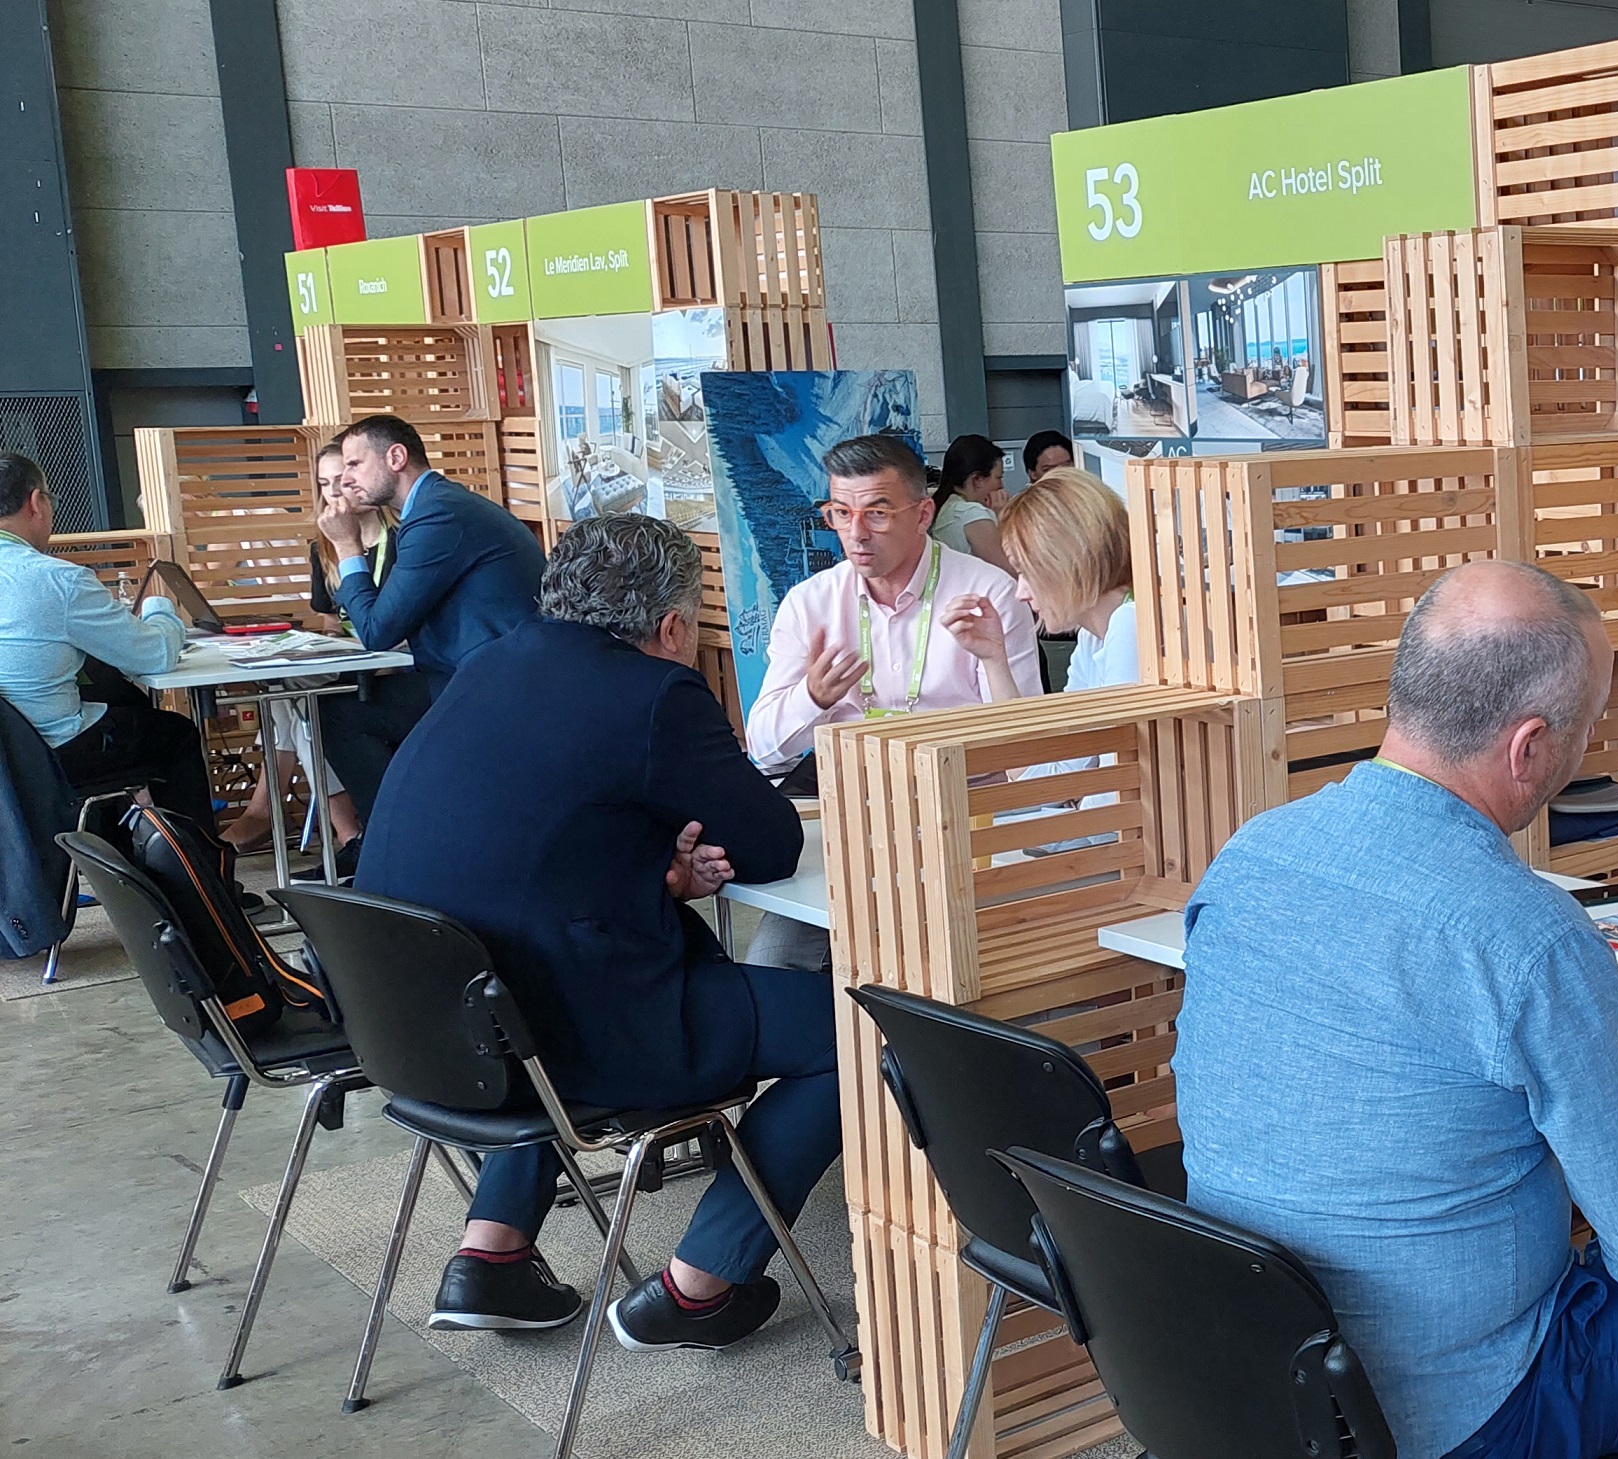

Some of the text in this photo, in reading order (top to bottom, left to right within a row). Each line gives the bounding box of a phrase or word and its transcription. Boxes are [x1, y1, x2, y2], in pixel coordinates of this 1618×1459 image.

[1248, 157, 1383, 200] AC Hotel Split
[309, 204, 328, 212] Visit
[1085, 161, 1144, 242] 53
[485, 247, 515, 298] 52
[544, 249, 630, 276] Le Meridien Lav, Split
[297, 271, 318, 315] 51
